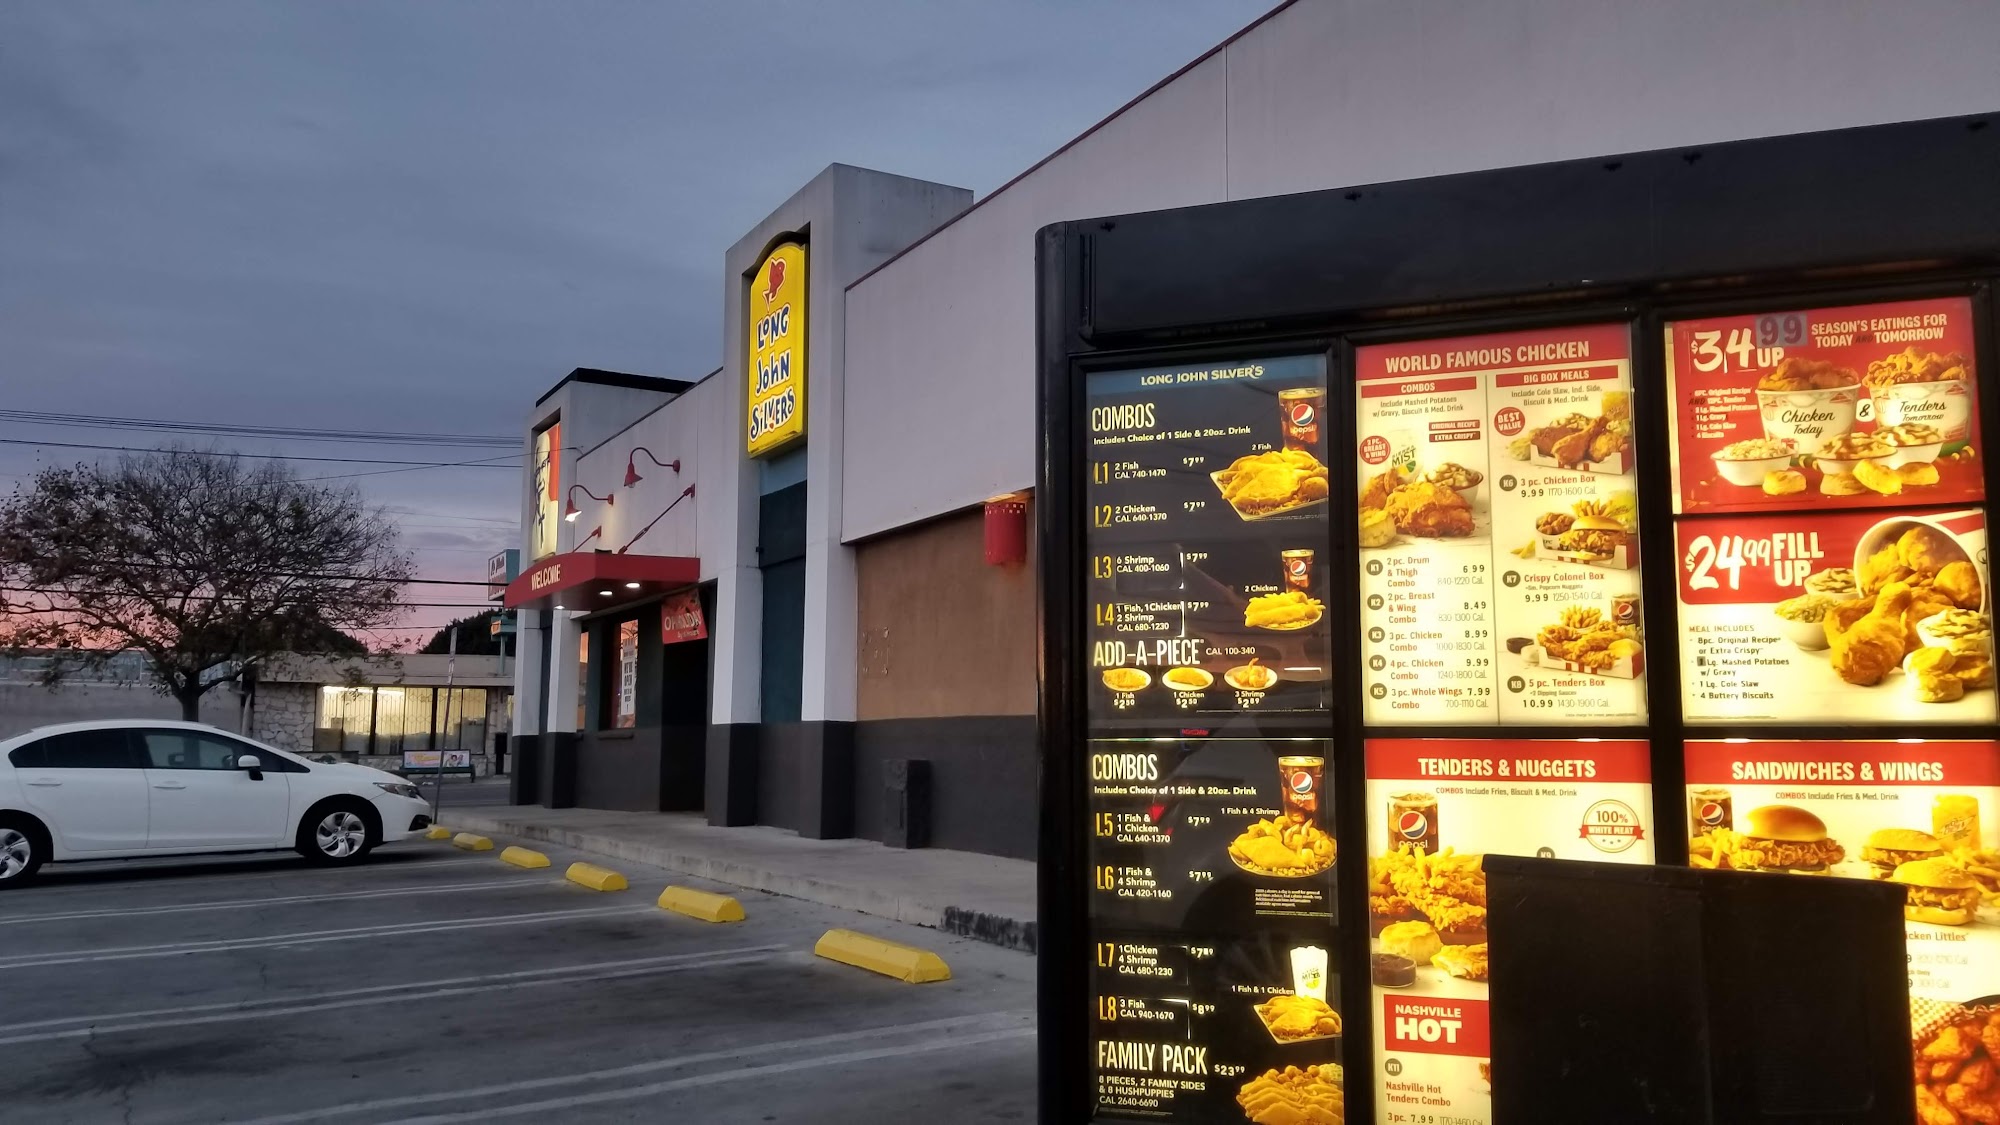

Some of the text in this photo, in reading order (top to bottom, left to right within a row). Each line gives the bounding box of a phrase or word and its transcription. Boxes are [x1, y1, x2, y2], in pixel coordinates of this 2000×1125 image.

[1812, 319, 1868, 336] SEASON'S
[1871, 316, 1921, 332] EATINGS
[1924, 314, 1947, 326] FOR
[1816, 335, 1853, 348] TODAY
[1874, 327, 1944, 344] TOMORROW
[1385, 341, 1590, 374] WORLD FAMOUS CHICKEN
[1757, 347, 1784, 367] UP
[1141, 366, 1263, 386] LONG JOHN SILVER'S
[1524, 369, 1589, 384] BIG BOX MEALS
[1401, 383, 1435, 393] COMBOS
[1092, 403, 1155, 431] COMBOS
[1498, 412, 1519, 423] BEST
[1782, 400, 1947, 424] Chicken & Tenders
[1499, 422, 1521, 431] VALUE
[1793, 413, 1944, 437] Today Tomorrow
[1094, 461, 1108, 485] L1
[1122, 462, 1139, 470] Fish
[1115, 469, 1166, 480] CAL 740-1470
[1503, 479, 1513, 487] K6
[1528, 479, 1541, 488] pc.
[1544, 476, 1577, 485] Chicken
[1580, 475, 1596, 483] Box
[1521, 489, 1544, 498] 9.99
[1094, 505, 1111, 528] L2
[1123, 504, 1155, 513] Chicken
[1773, 532, 1824, 559] FILL
[1094, 555, 1112, 579] L3
[1124, 555, 1154, 565] Shrimp
[1774, 560, 1811, 586] UP
[532, 564, 561, 591] WELCOME
[1506, 572, 1605, 585] K7 Crispy Colonel Box
[1097, 603, 1114, 626] L4
[1124, 604, 1143, 613] Fish,
[1717, 636, 1748, 645] Original
[1751, 635, 1777, 645] Recipe
[1206, 647, 1222, 655] CAL
[1225, 647, 1255, 655] 100-340
[1710, 646, 1732, 655] Extra
[1734, 646, 1759, 656] Crispy
[1411, 659, 1443, 667] Chicken
[1412, 687, 1436, 696] Whole
[1438, 687, 1462, 696] Wings
[1537, 679, 1550, 689] pc.
[1552, 677, 1586, 687] Tenders
[1589, 678, 1605, 687] Box
[1709, 692, 1739, 701] Buttery
[1742, 692, 1774, 700] Biscuits
[1092, 754, 1157, 781] COMBOS
[1418, 758, 1596, 778] TENDERS & NUGGETS
[1732, 762, 1944, 781] SANDWICHES & WINGS
[1776, 792, 1806, 800] COMBOS
[1808, 792, 1834, 800] Include
[1836, 792, 1853, 800] Fries
[1862, 792, 1879, 801] Med.
[1880, 792, 1899, 801] Drink
[1096, 812, 1113, 837] L5
[1125, 814, 1142, 822] Fish
[1144, 814, 1150, 822] &
[1596, 810, 1628, 824] 100%
[1588, 825, 1634, 835] WHITE MEAT
[1096, 865, 1114, 890] L6
[1126, 867, 1143, 876] Fish
[1145, 868, 1152, 876] &
[1099, 995, 1116, 1021] L8
[1120, 999, 1126, 1007] 3
[1128, 999, 1145, 1009] Fish
[1396, 1004, 1461, 1018] NASHVILLE
[1396, 1017, 1462, 1044] HOT
[1098, 1041, 1155, 1071] FAMILY
[1163, 1044, 1207, 1075] PACK
[1099, 1086, 1105, 1095] &
[1115, 1087, 1174, 1098] HUSHPUPPIES
[1106, 1076, 1138, 1087] PIECES,
[1140, 1078, 1146, 1086] 2
[1147, 1078, 1178, 1089] FAMILY
[1181, 1080, 1205, 1091] SIDES
[1386, 1081, 1441, 1094] Nashville Hot
[1387, 1093, 1451, 1107] Tenders Combo
